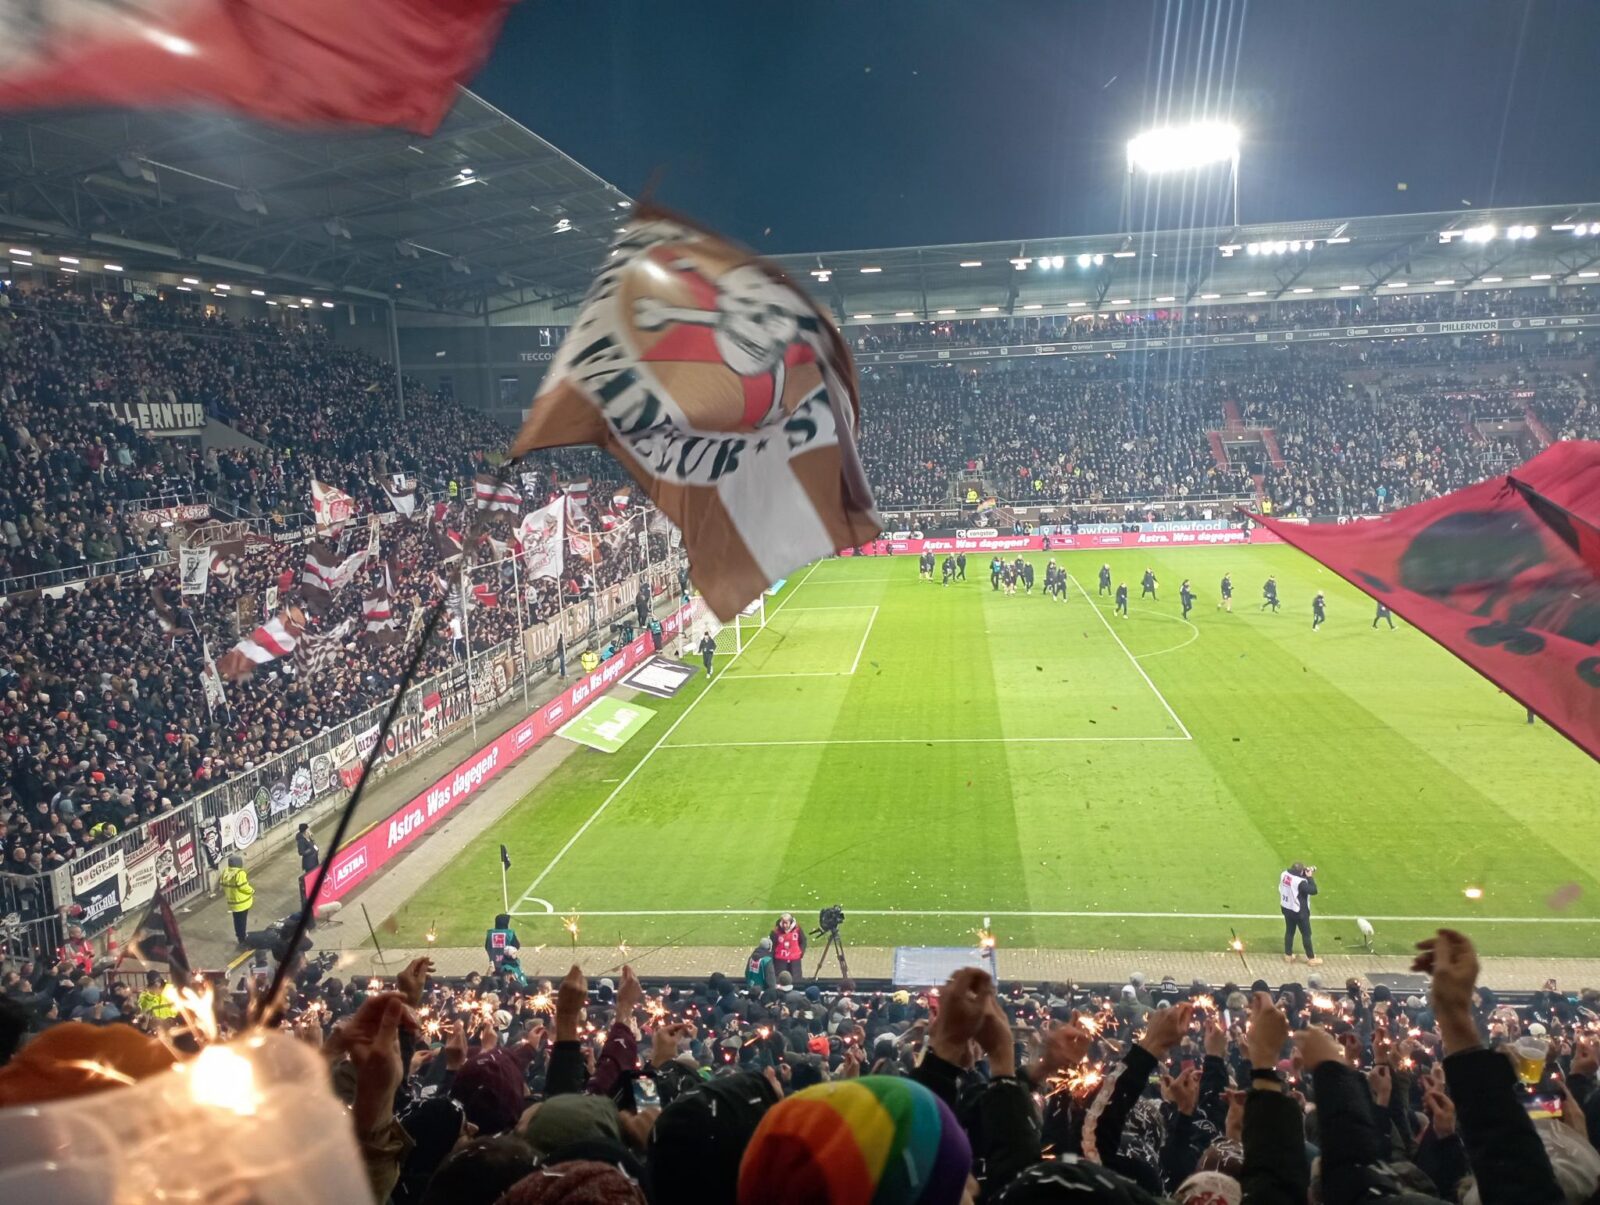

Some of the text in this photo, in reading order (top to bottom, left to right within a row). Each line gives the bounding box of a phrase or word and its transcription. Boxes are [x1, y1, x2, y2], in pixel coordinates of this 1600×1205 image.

[1441, 321, 1497, 332] MILLERNTOR
[88, 402, 206, 429] LLERNTOR
[1153, 520, 1221, 532] followfood
[922, 538, 1031, 550] Astra. Was dagegen?
[1137, 533, 1169, 543] Astra.
[1173, 533, 1195, 542] Was
[571, 684, 590, 706] Astra.
[590, 673, 603, 692] Was
[387, 746, 498, 849] Astra. Was dagegen?
[336, 854, 365, 881] ASTRA
